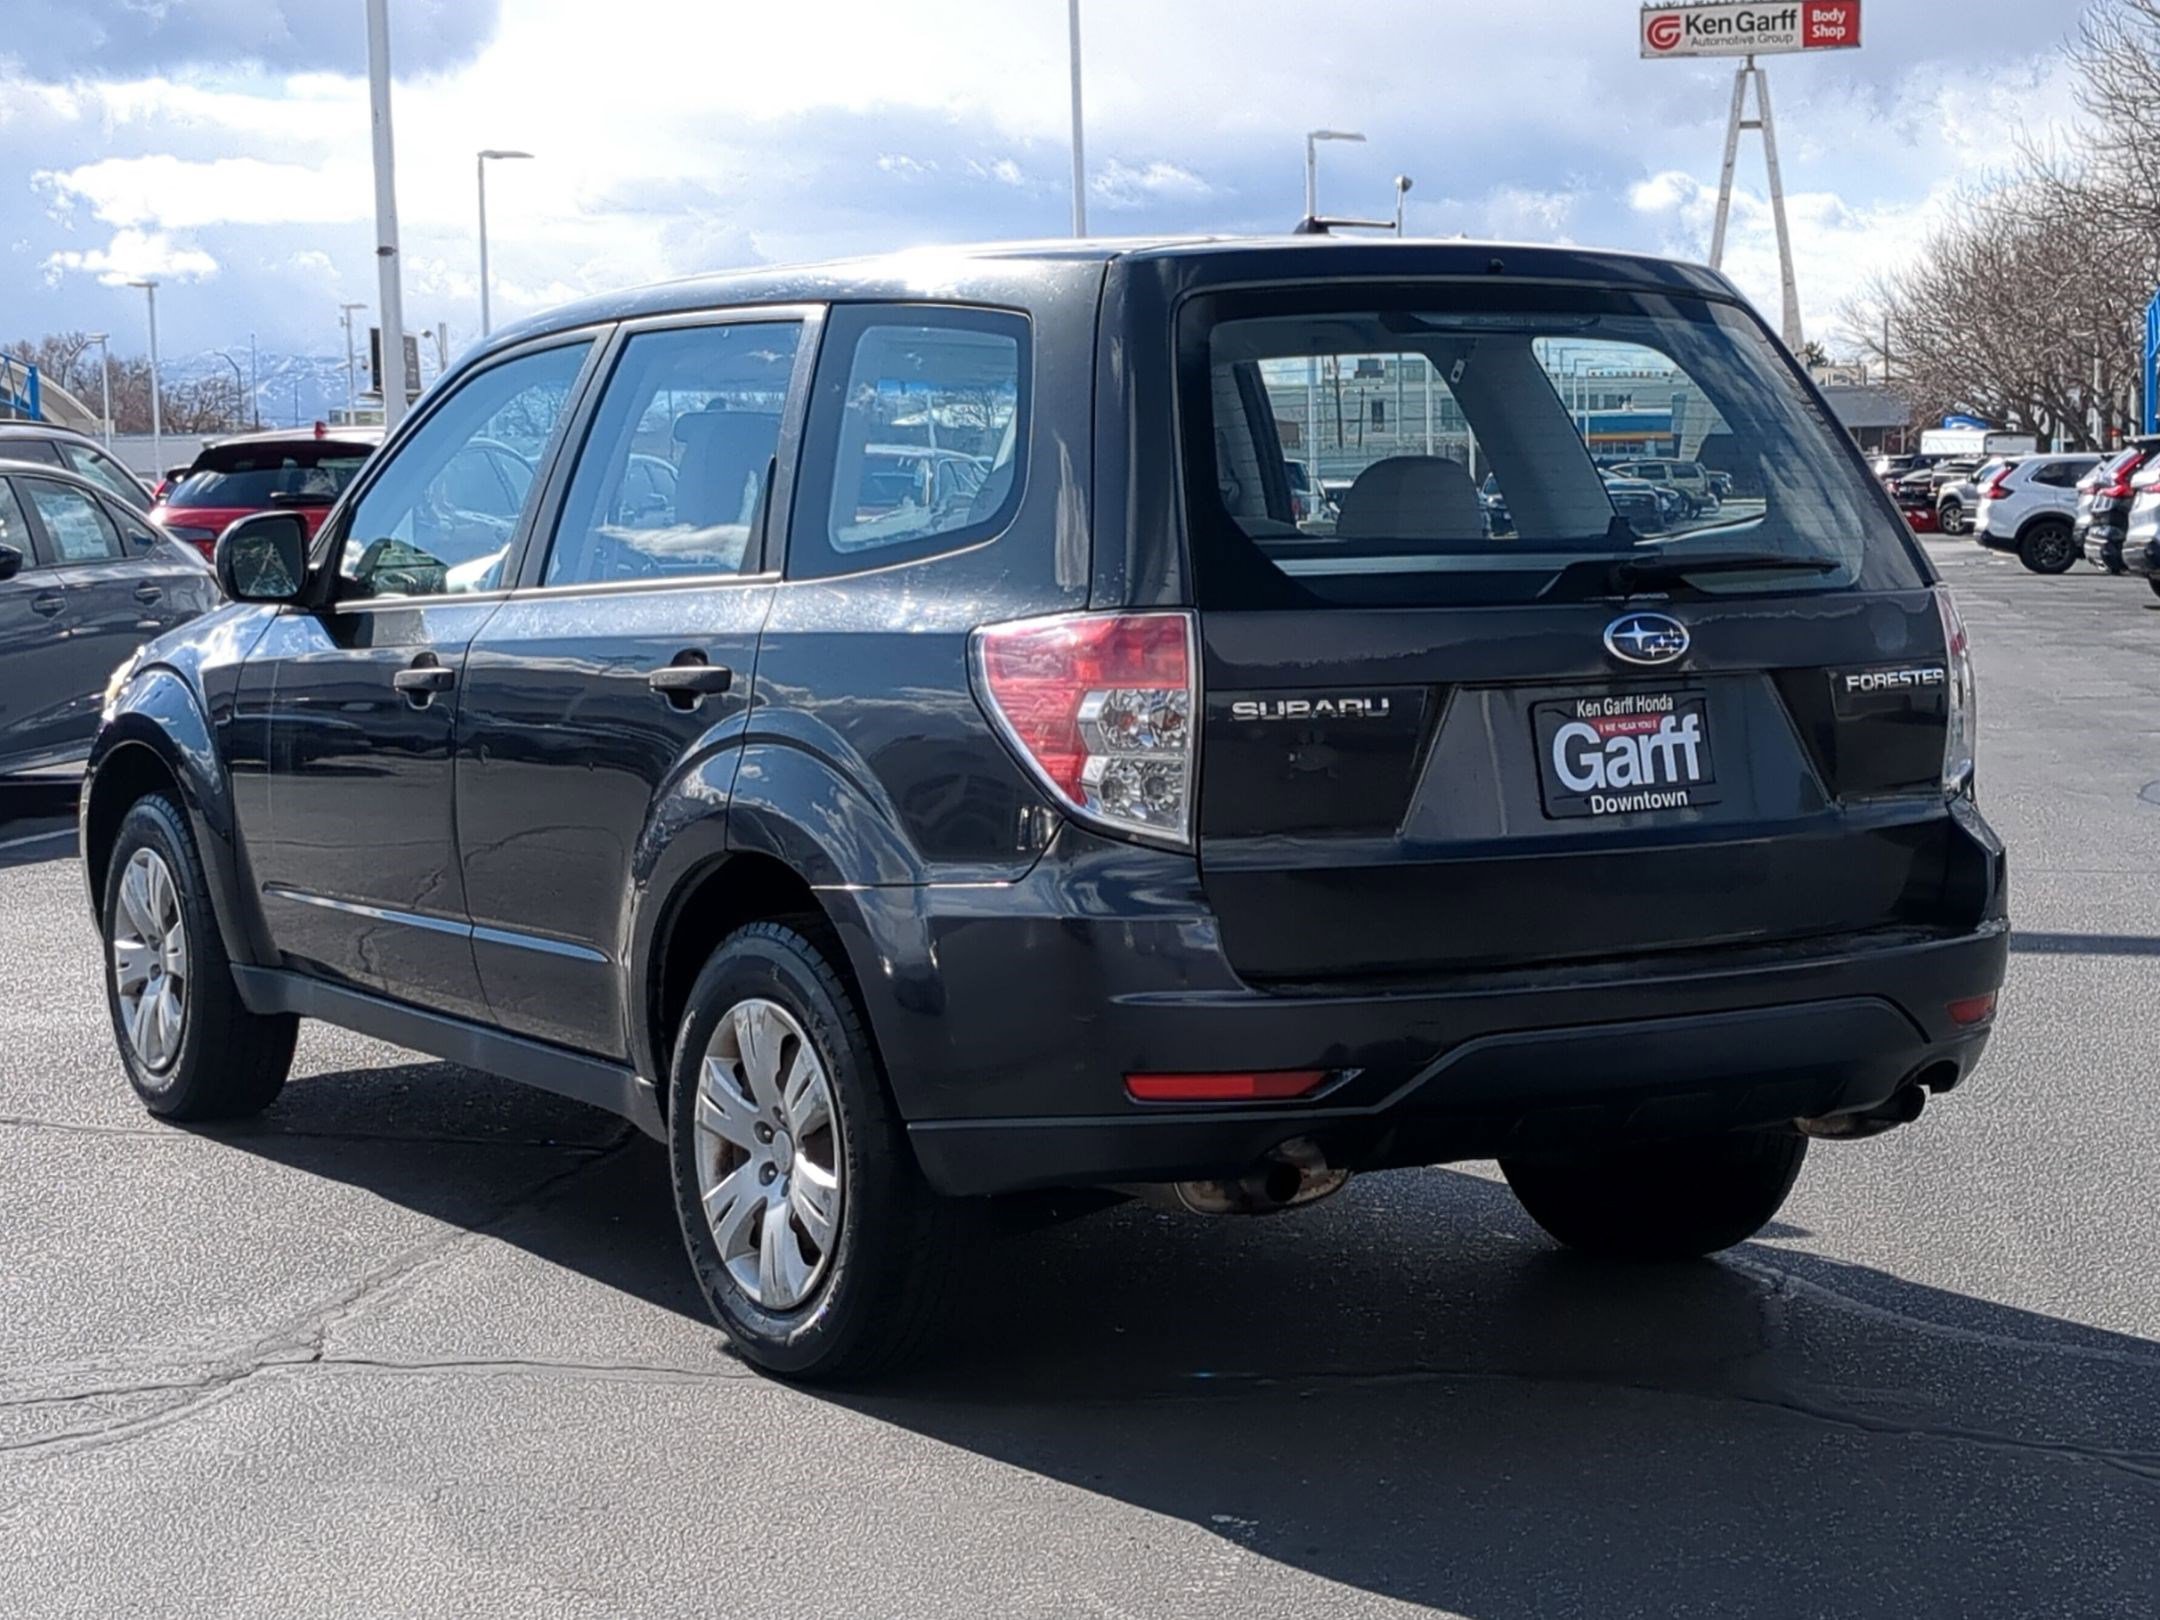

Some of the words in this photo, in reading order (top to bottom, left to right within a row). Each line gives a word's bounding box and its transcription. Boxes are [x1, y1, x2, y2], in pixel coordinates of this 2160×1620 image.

[1685, 13, 1732, 35] Ken
[1735, 9, 1797, 33] Garff
[1811, 9, 1846, 24] Body
[1690, 34, 1754, 48] Automotive
[1757, 33, 1794, 46] Group
[1811, 24, 1846, 40] Shop
[1845, 668, 1945, 692] FORESTER
[1231, 697, 1390, 721] SUBARU
[1576, 699, 1601, 718] Ken
[1603, 695, 1634, 717] Garff
[1635, 693, 1674, 714] Honda
[1552, 713, 1701, 793] Garff
[1590, 790, 1689, 814] Downtown
